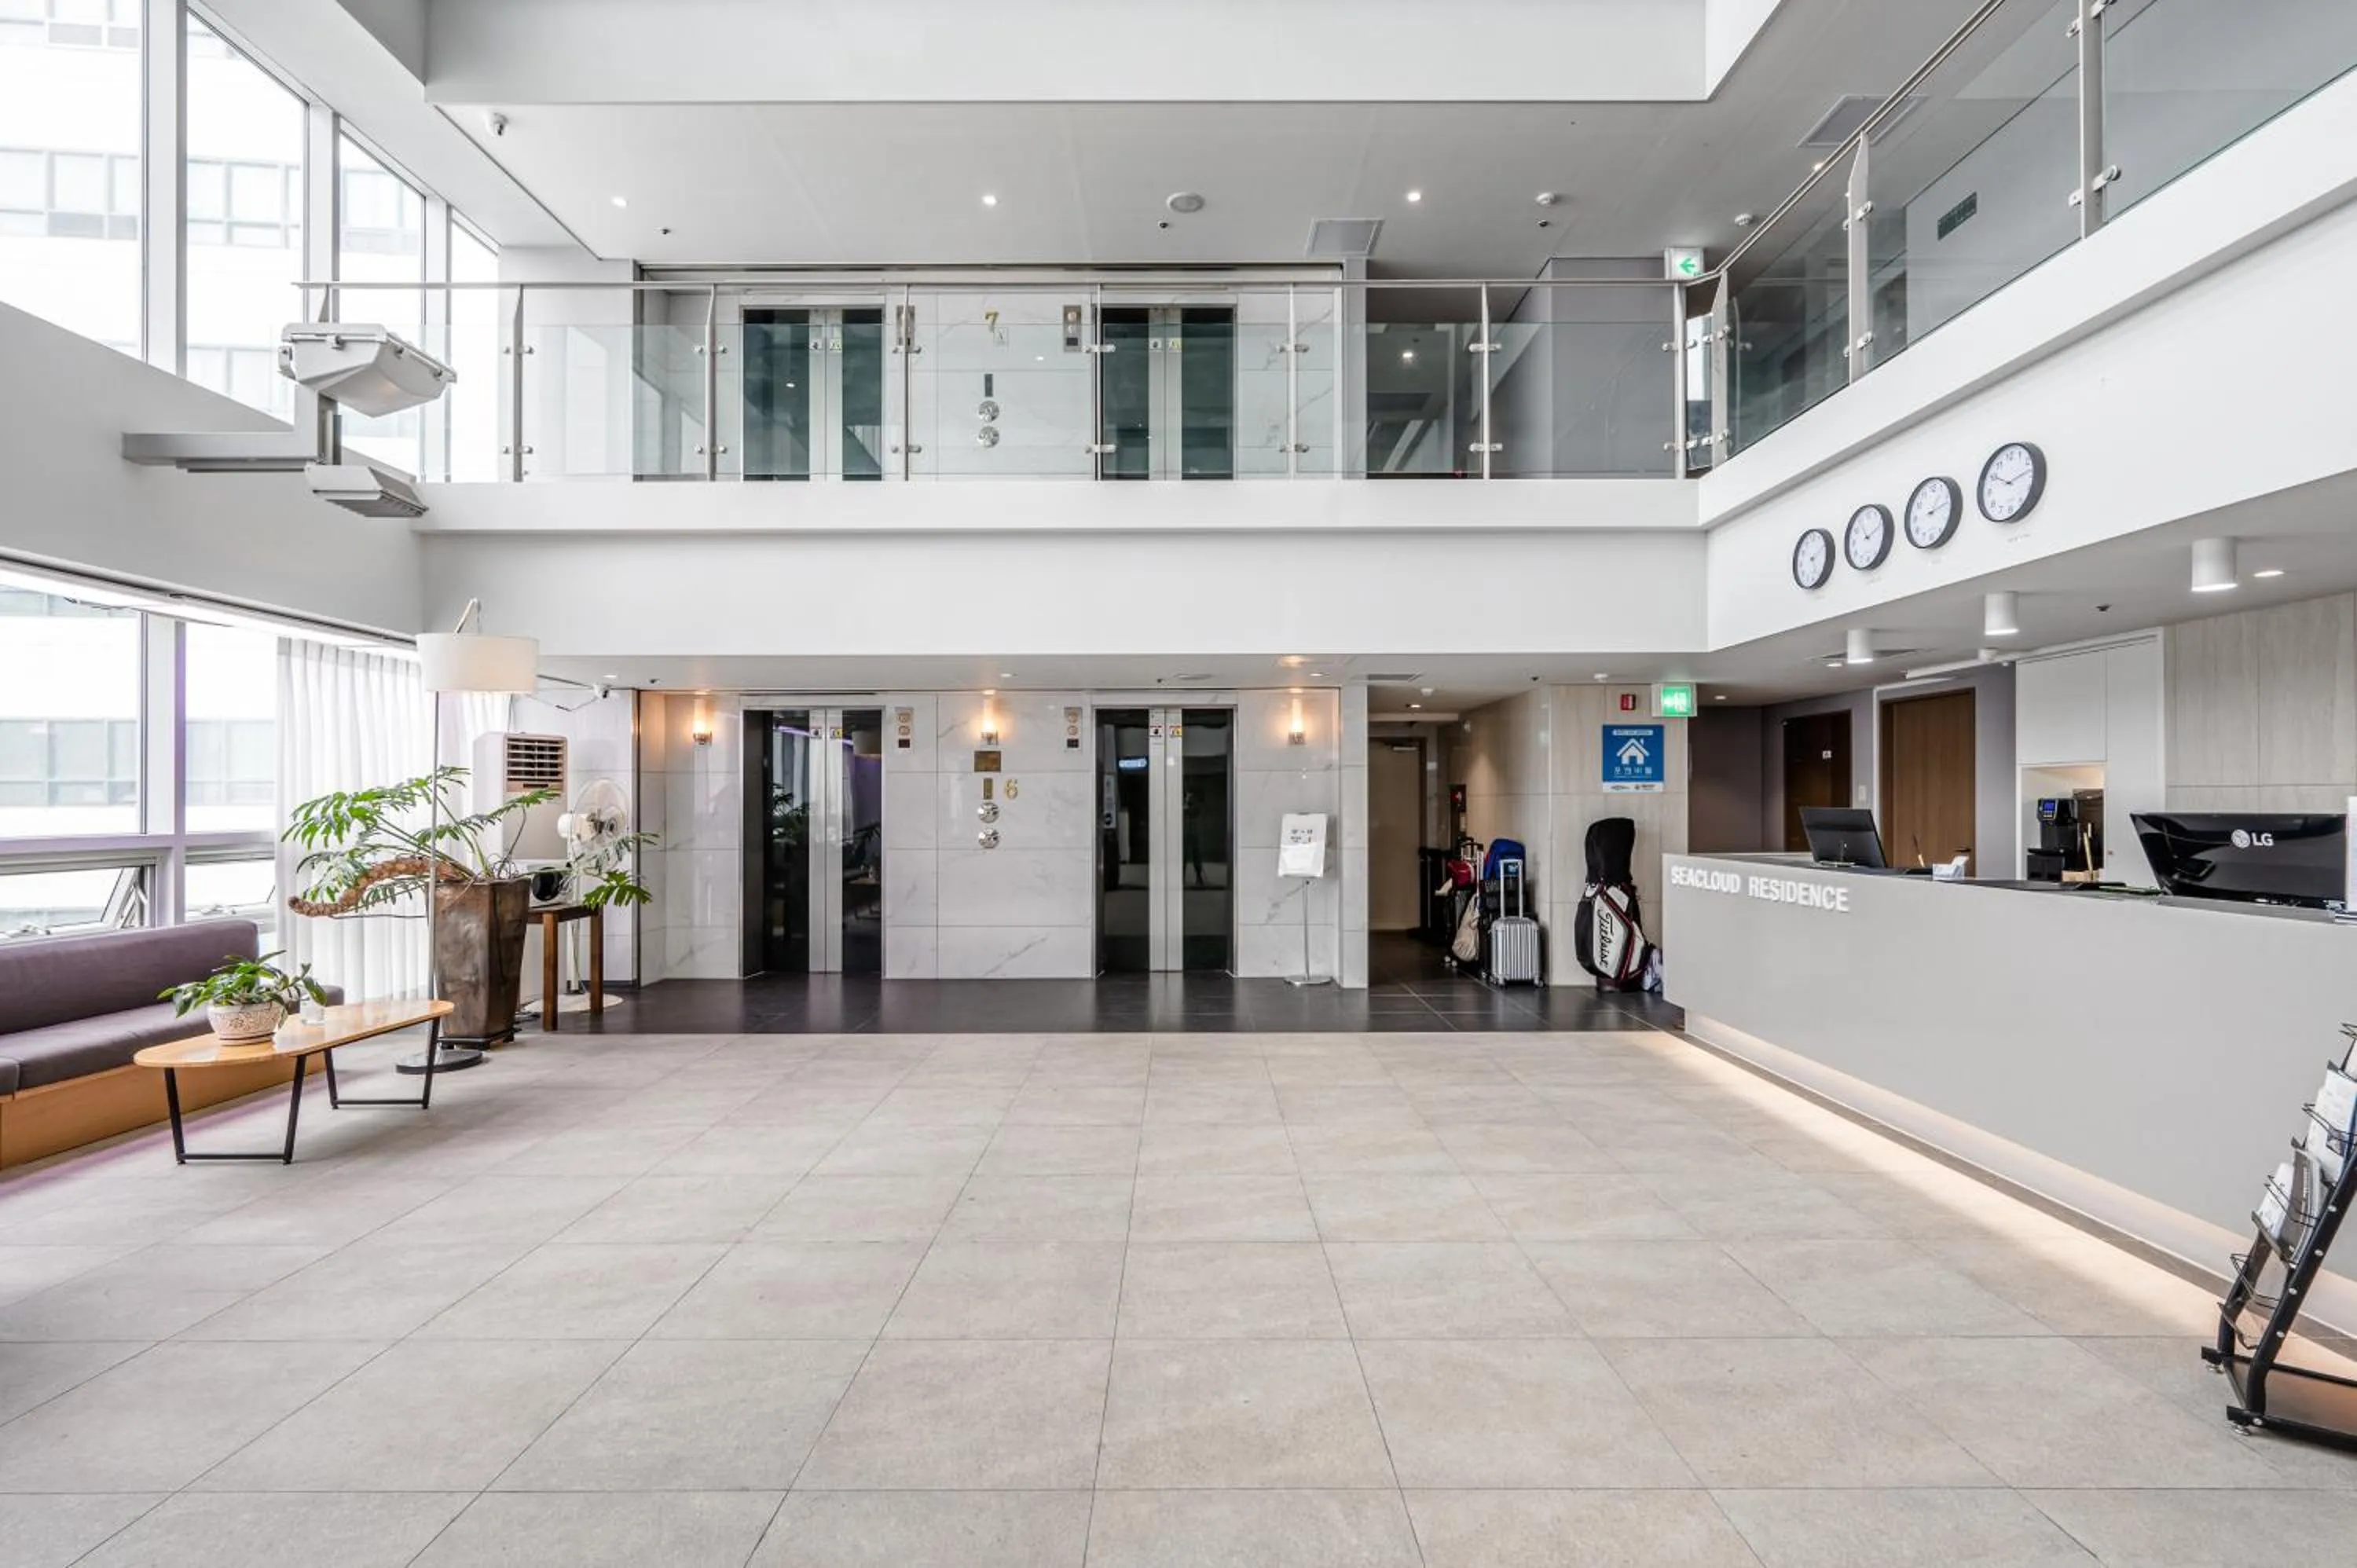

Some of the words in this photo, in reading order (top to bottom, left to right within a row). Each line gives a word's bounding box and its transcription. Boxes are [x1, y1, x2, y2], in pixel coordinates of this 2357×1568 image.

[2252, 833, 2275, 846] LG
[1670, 866, 1741, 893] SEACLOUD
[1748, 876, 1849, 911] RESIDENCE
